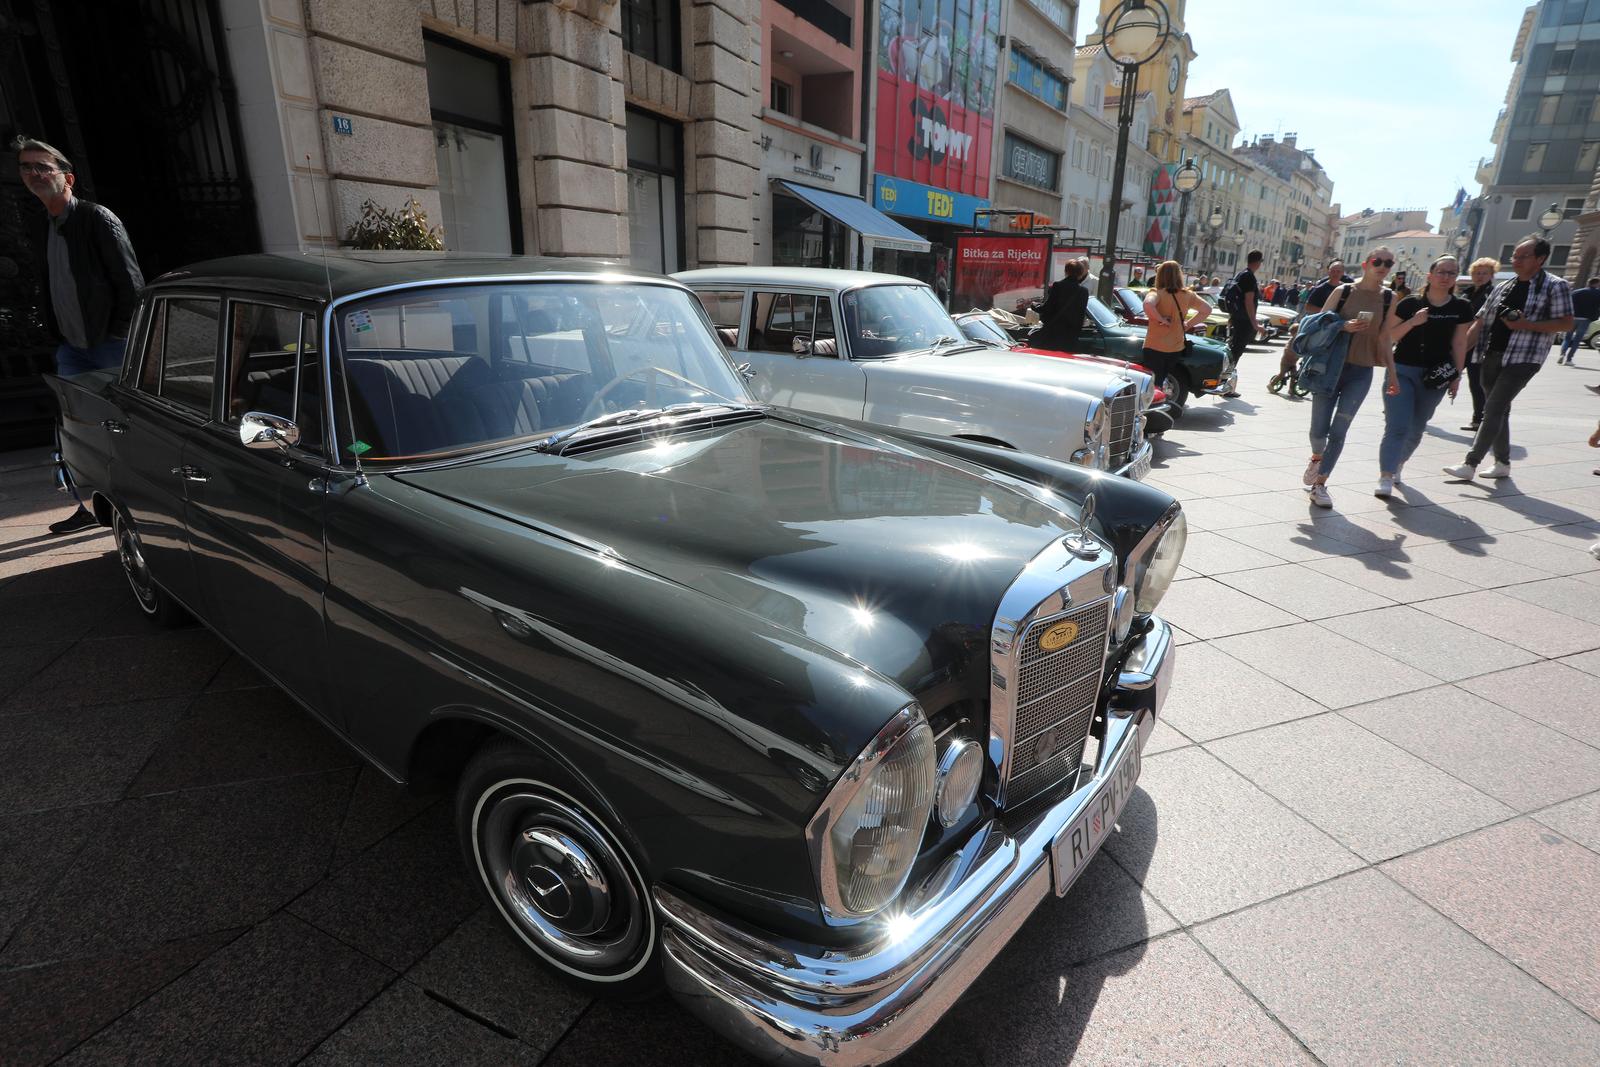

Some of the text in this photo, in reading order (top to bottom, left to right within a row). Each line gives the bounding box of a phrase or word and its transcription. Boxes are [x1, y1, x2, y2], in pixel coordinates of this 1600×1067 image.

[337, 118, 349, 130] 16
[921, 116, 973, 162] TOMMY
[880, 186, 897, 202] TEDi
[927, 191, 953, 218] TEDi
[963, 247, 989, 259] Bitka
[992, 250, 1004, 259] za
[1007, 249, 1041, 262] Rijeku
[1071, 816, 1091, 869] RI
